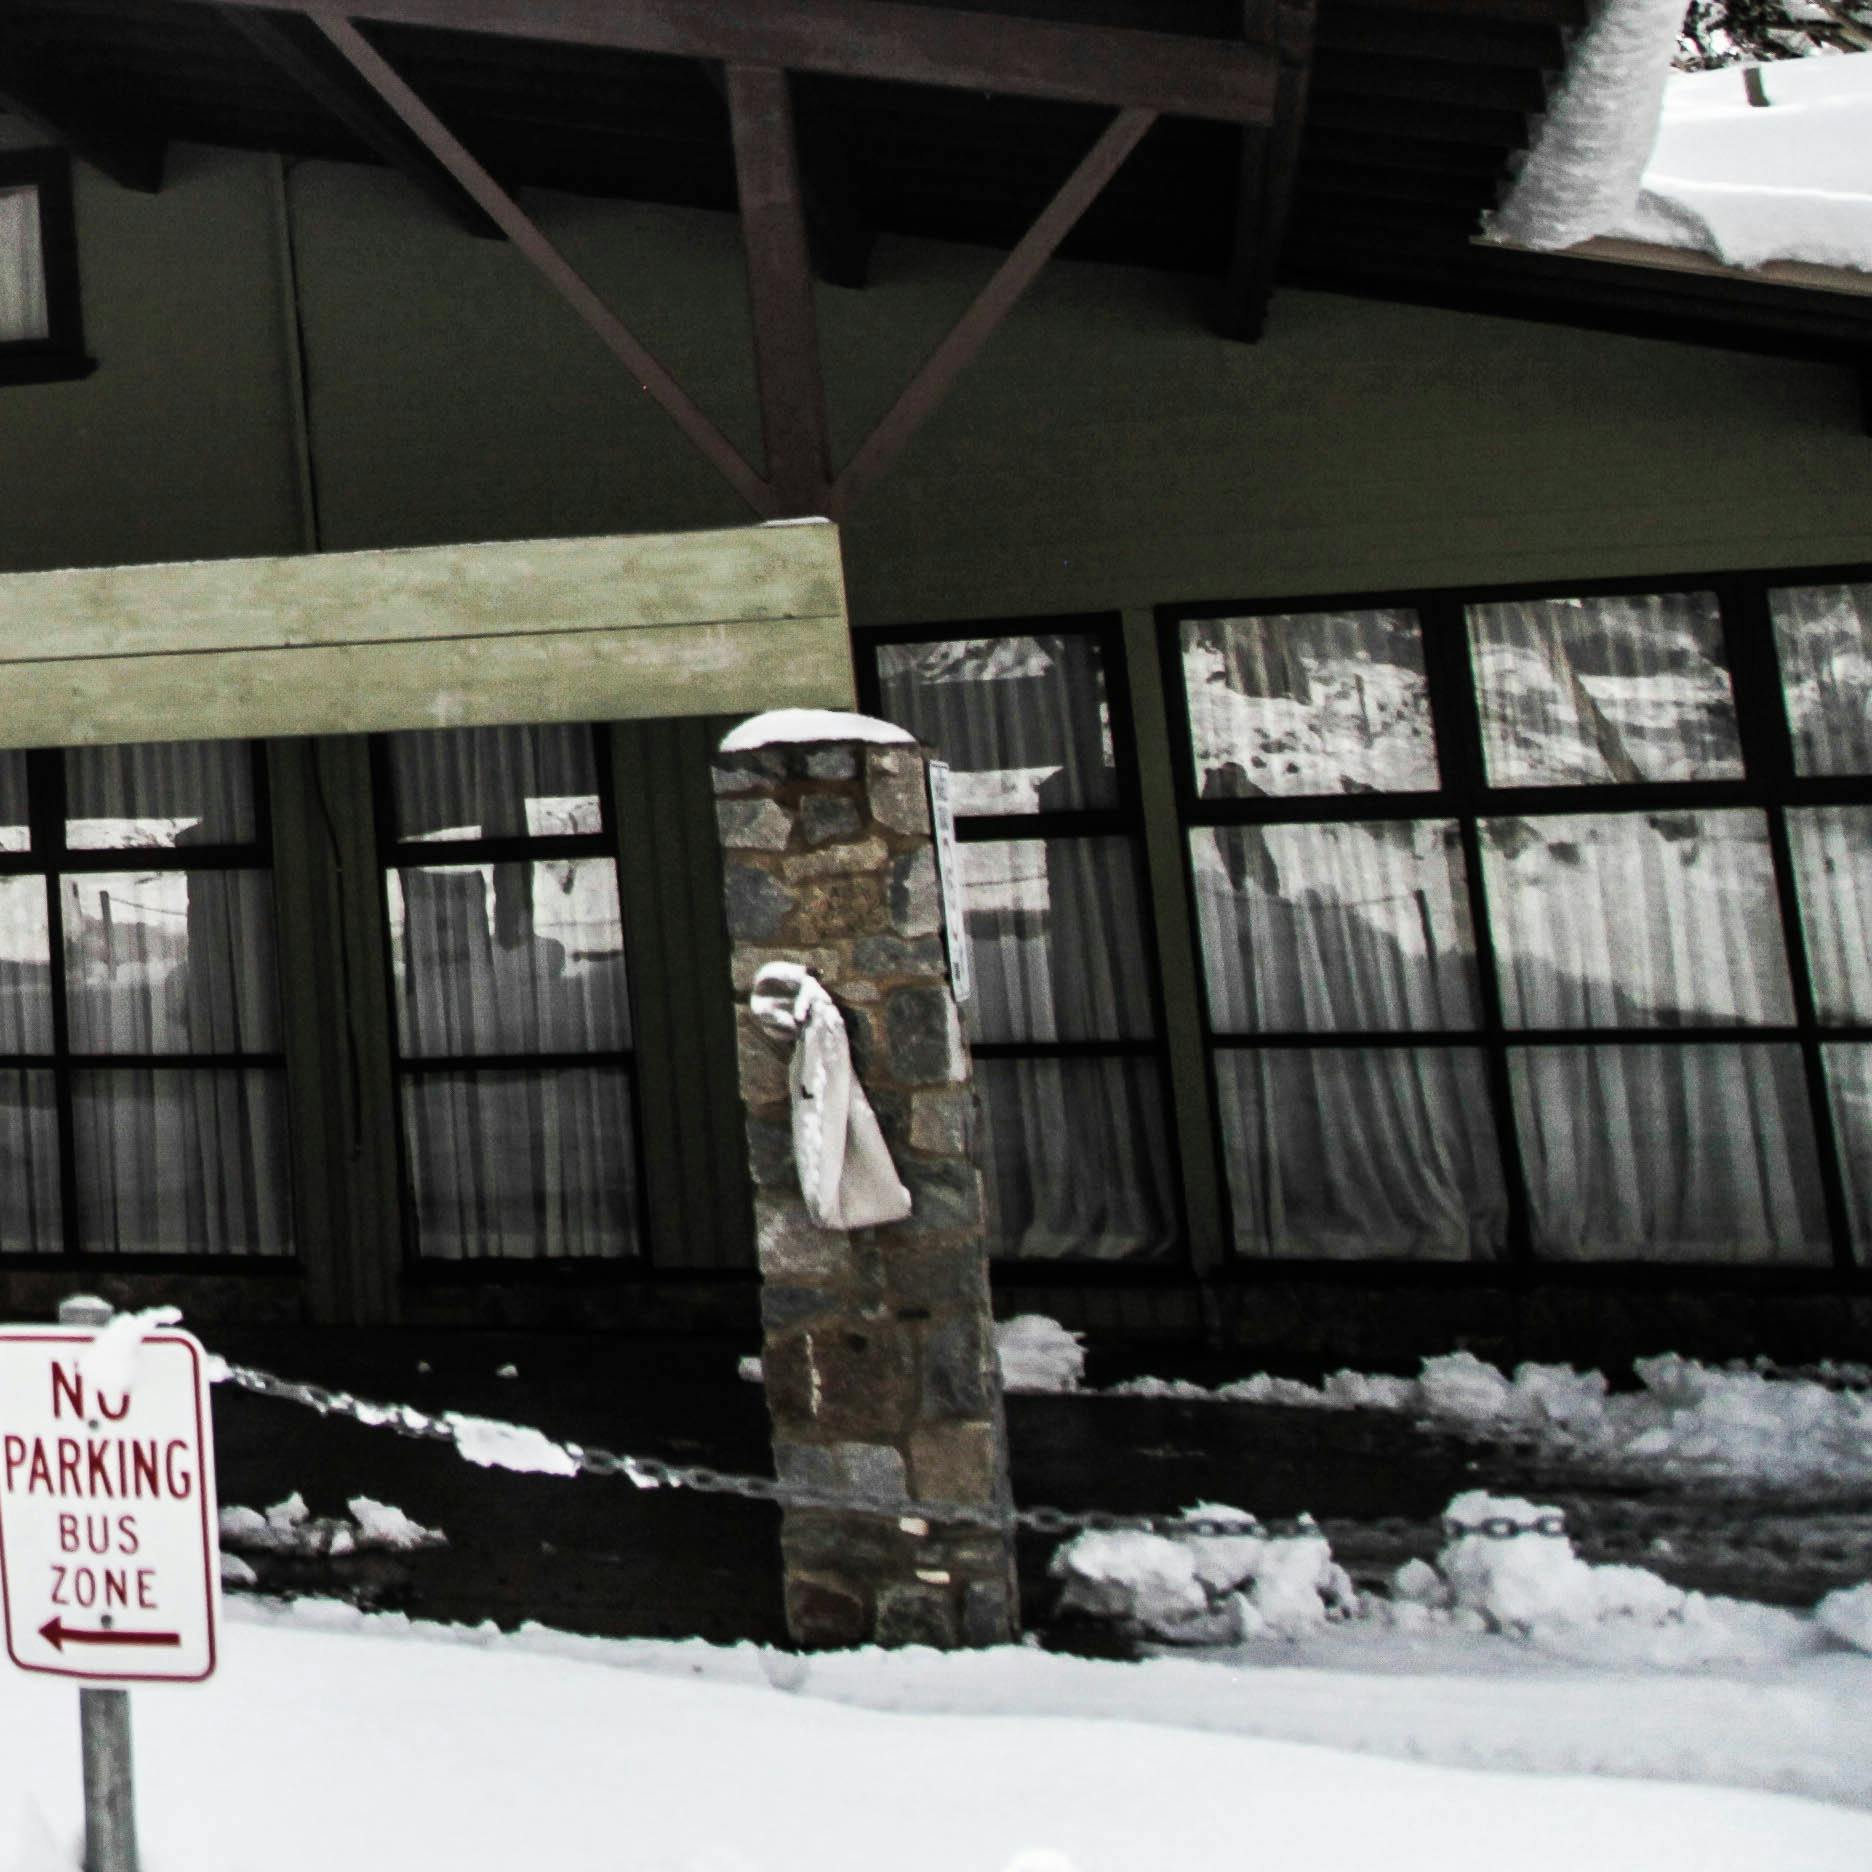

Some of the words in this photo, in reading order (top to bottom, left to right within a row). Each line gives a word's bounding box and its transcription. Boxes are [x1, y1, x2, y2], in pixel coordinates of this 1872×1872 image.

[4, 1434, 192, 1500] PARKING
[59, 1513, 139, 1554] BUS
[51, 1565, 158, 1609] ZONE
